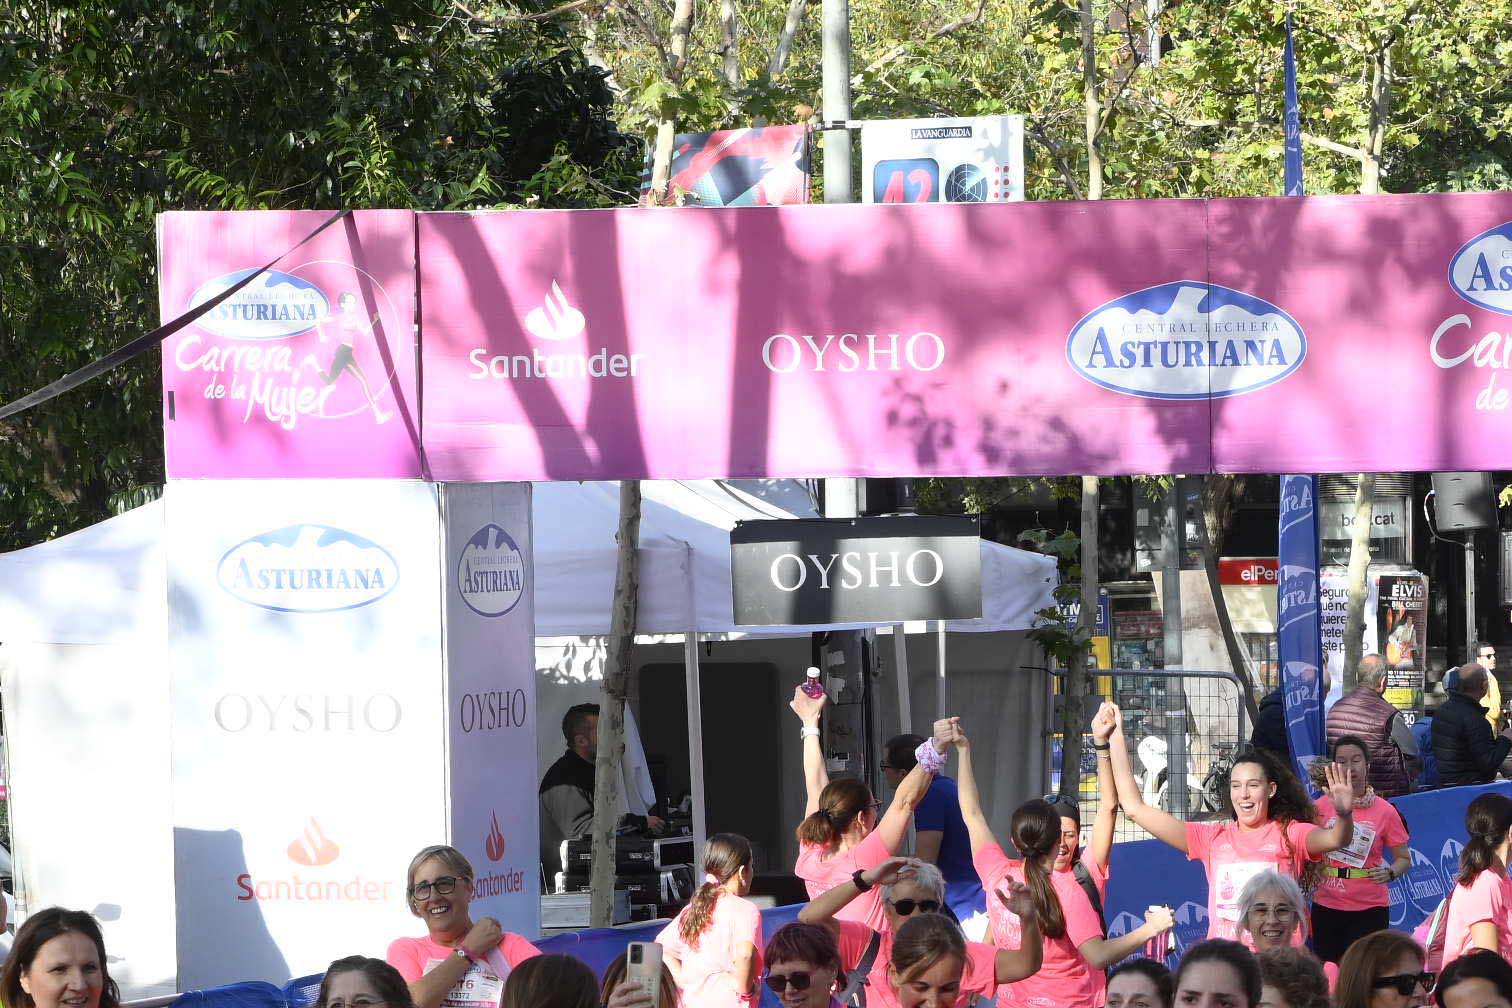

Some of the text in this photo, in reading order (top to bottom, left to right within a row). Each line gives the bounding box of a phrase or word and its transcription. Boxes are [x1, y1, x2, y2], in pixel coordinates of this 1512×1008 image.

[922, 127, 970, 138] VANGUARDIA
[1086, 323, 1288, 370] ASTURIANA
[1122, 321, 1280, 335] CENTRAL LECHERA
[175, 336, 292, 373] Carrera
[468, 347, 641, 380] Santander
[762, 332, 945, 373] OYSHO
[204, 371, 336, 430] de la Mujer
[1475, 373, 1508, 411] de
[232, 557, 386, 591] ASTURIANA
[463, 560, 521, 595] ASTURIANA
[770, 548, 945, 592] OYSHO
[1392, 585, 1422, 597] ELVIS
[213, 692, 402, 734] OYSHO
[460, 688, 527, 733] OYSHO
[237, 872, 392, 902] Santander
